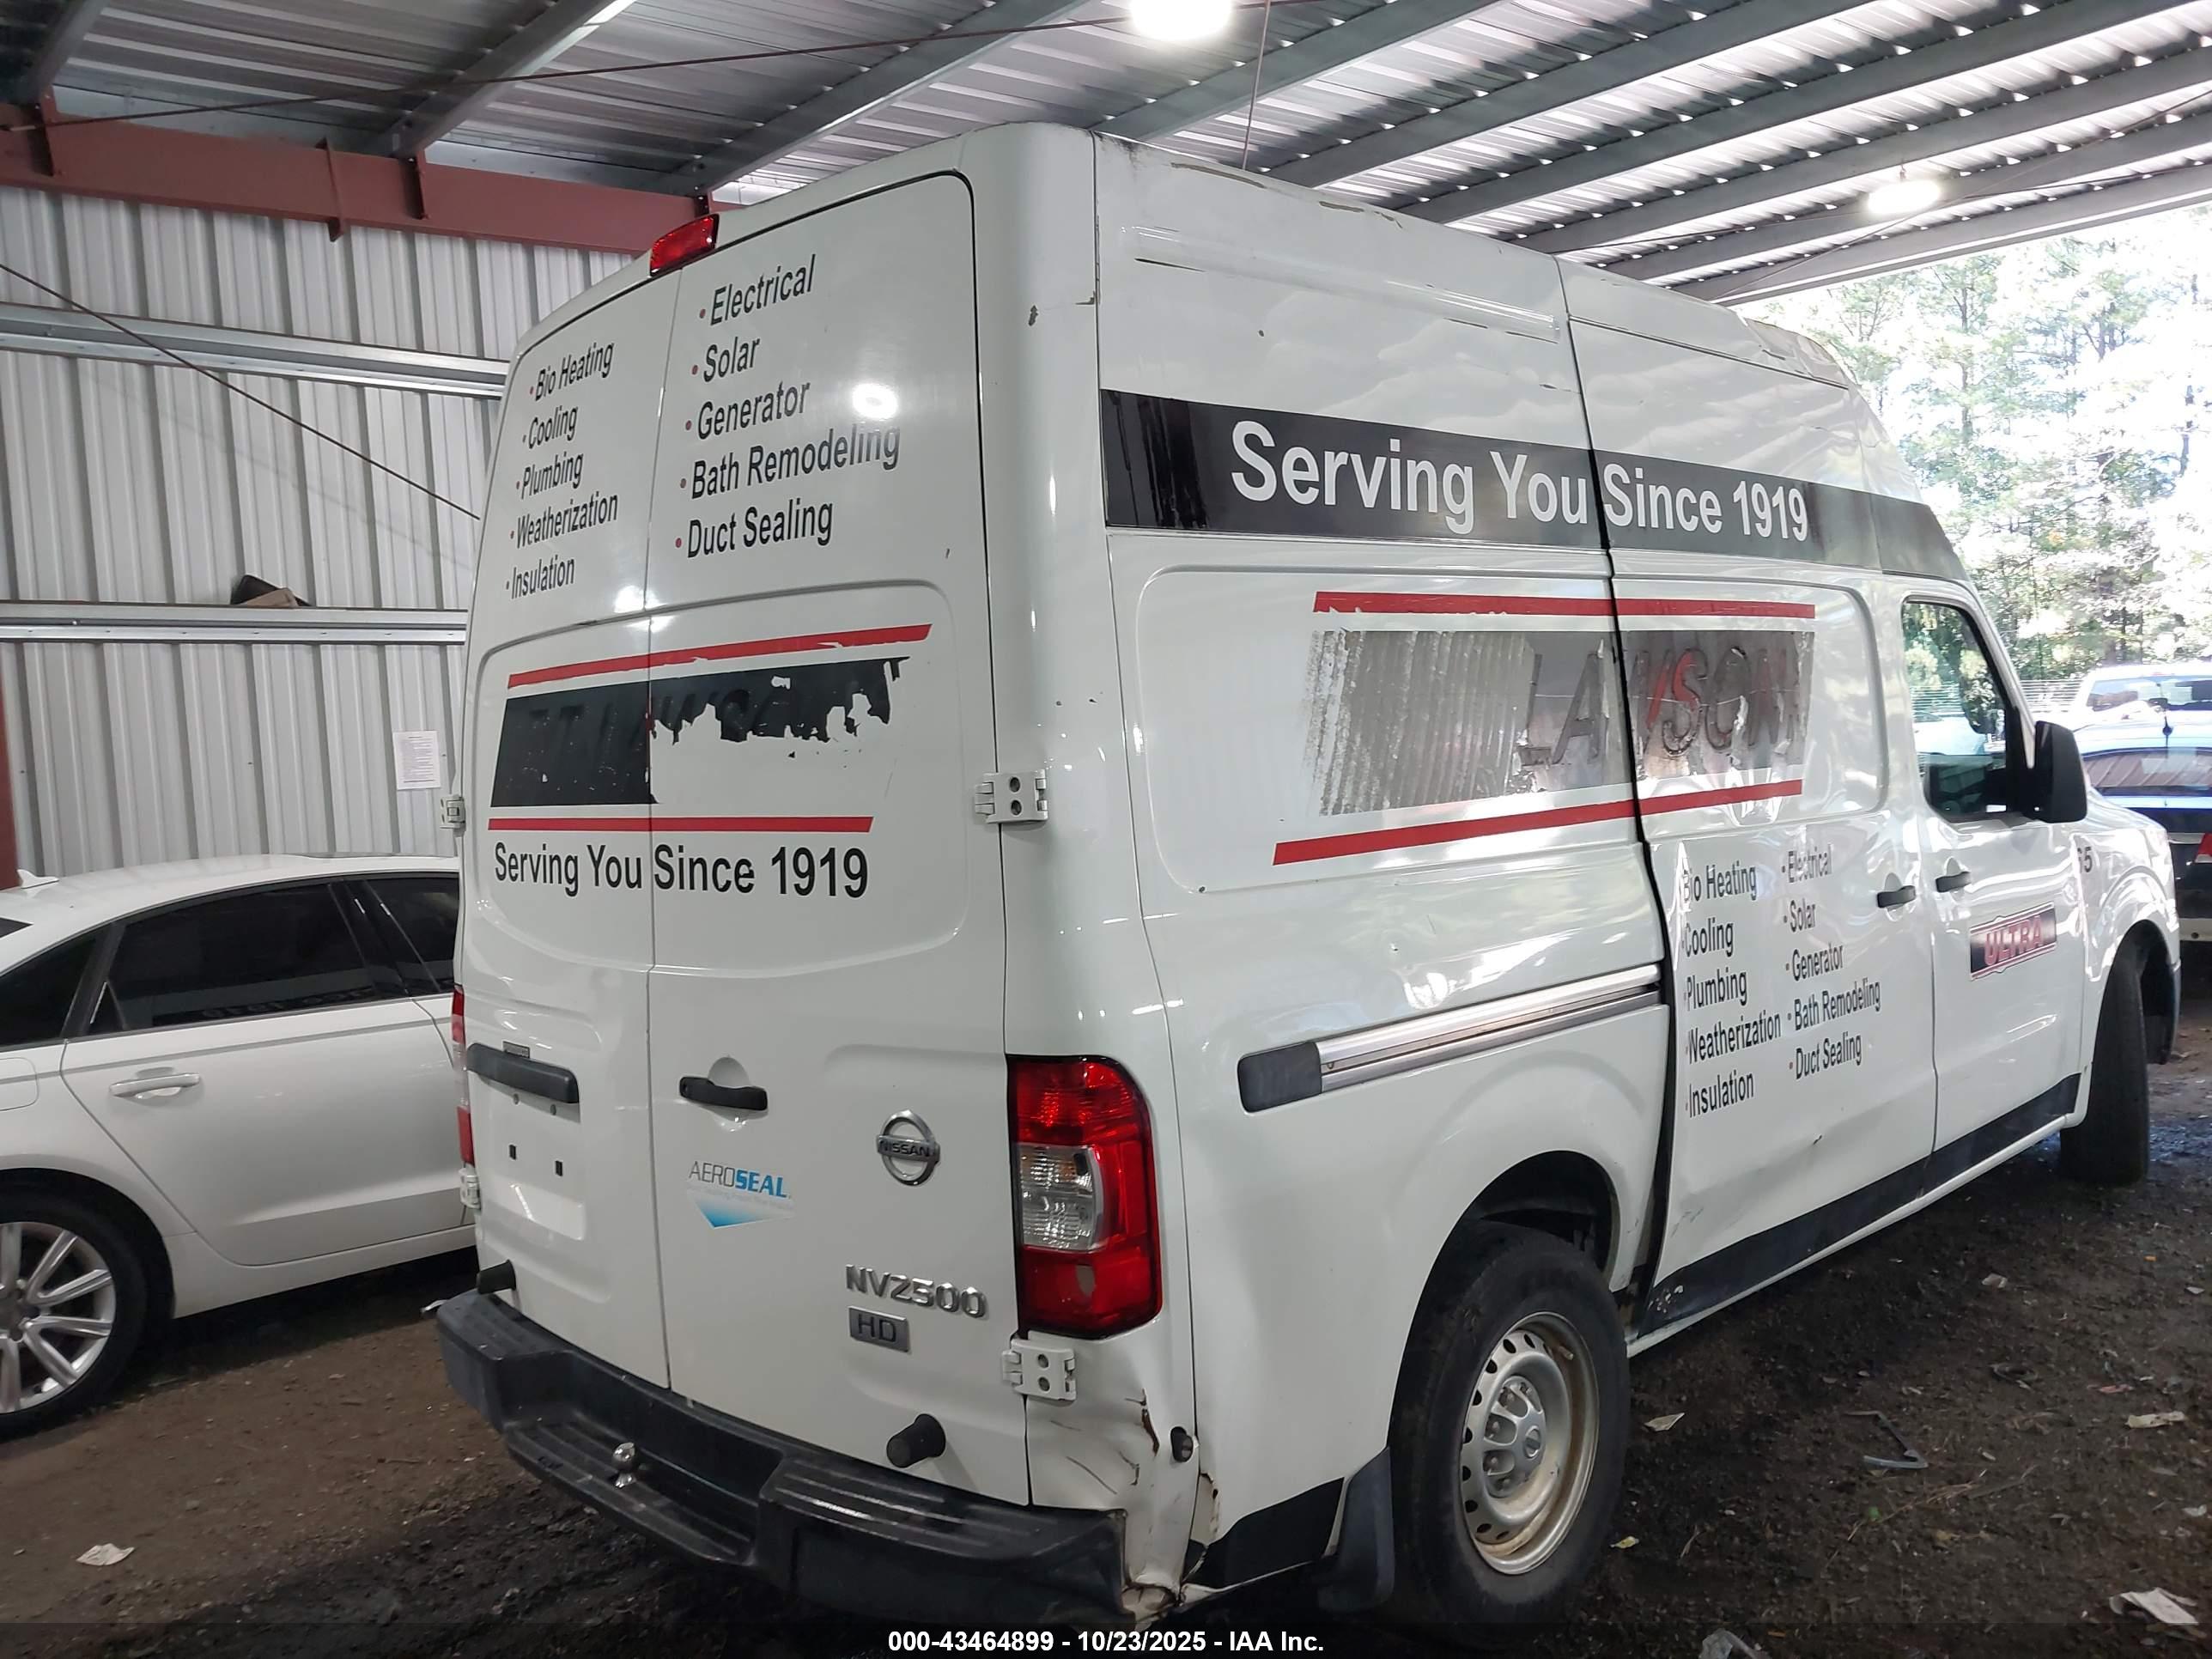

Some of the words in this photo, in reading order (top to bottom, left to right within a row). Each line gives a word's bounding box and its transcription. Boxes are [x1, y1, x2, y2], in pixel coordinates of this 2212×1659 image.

[710, 254, 817, 326] Electrical
[535, 368, 557, 401] Bio
[559, 342, 614, 386] Heating
[703, 337, 760, 381] Solar
[528, 405, 579, 449] Cooling
[697, 382, 811, 440] Generator
[521, 452, 584, 500] Plumbing
[692, 452, 739, 500] Bath
[748, 424, 901, 487] Remodeling
[1231, 421, 1475, 535] Serving
[1490, 452, 1588, 526] You
[1602, 464, 1723, 533] Since
[1732, 481, 1809, 541] 1919
[517, 492, 619, 548] Weatherization
[687, 516, 737, 559] Duct
[743, 498, 834, 547] Sealing
[512, 555, 574, 599] Insulation
[495, 842, 580, 896] Serving
[586, 844, 642, 889] You
[653, 843, 755, 894] Since
[771, 846, 869, 898] 1919
[1706, 860, 1757, 901] Heating
[1788, 844, 1833, 883] Electrical
[1685, 917, 1734, 957] Cooling
[1790, 899, 1816, 933] Solar
[1984, 914, 2042, 966] ULTRA
[1791, 943, 1844, 981] Generator
[1686, 967, 1747, 1012] Plumbing
[1794, 994, 1820, 1030] Bath
[1822, 978, 1881, 1024] Remodeling
[1688, 1009, 1782, 1065] Weatherization
[1796, 1043, 1820, 1079] Duct
[1822, 1032, 1863, 1072] Sealing
[1689, 1069, 1754, 1118] Insulation
[879, 1139, 931, 1157] NISSAN
[689, 1161, 787, 1198] AEROSEAL
[845, 1264, 988, 1318] NV2500
[858, 1315, 896, 1341] HD
